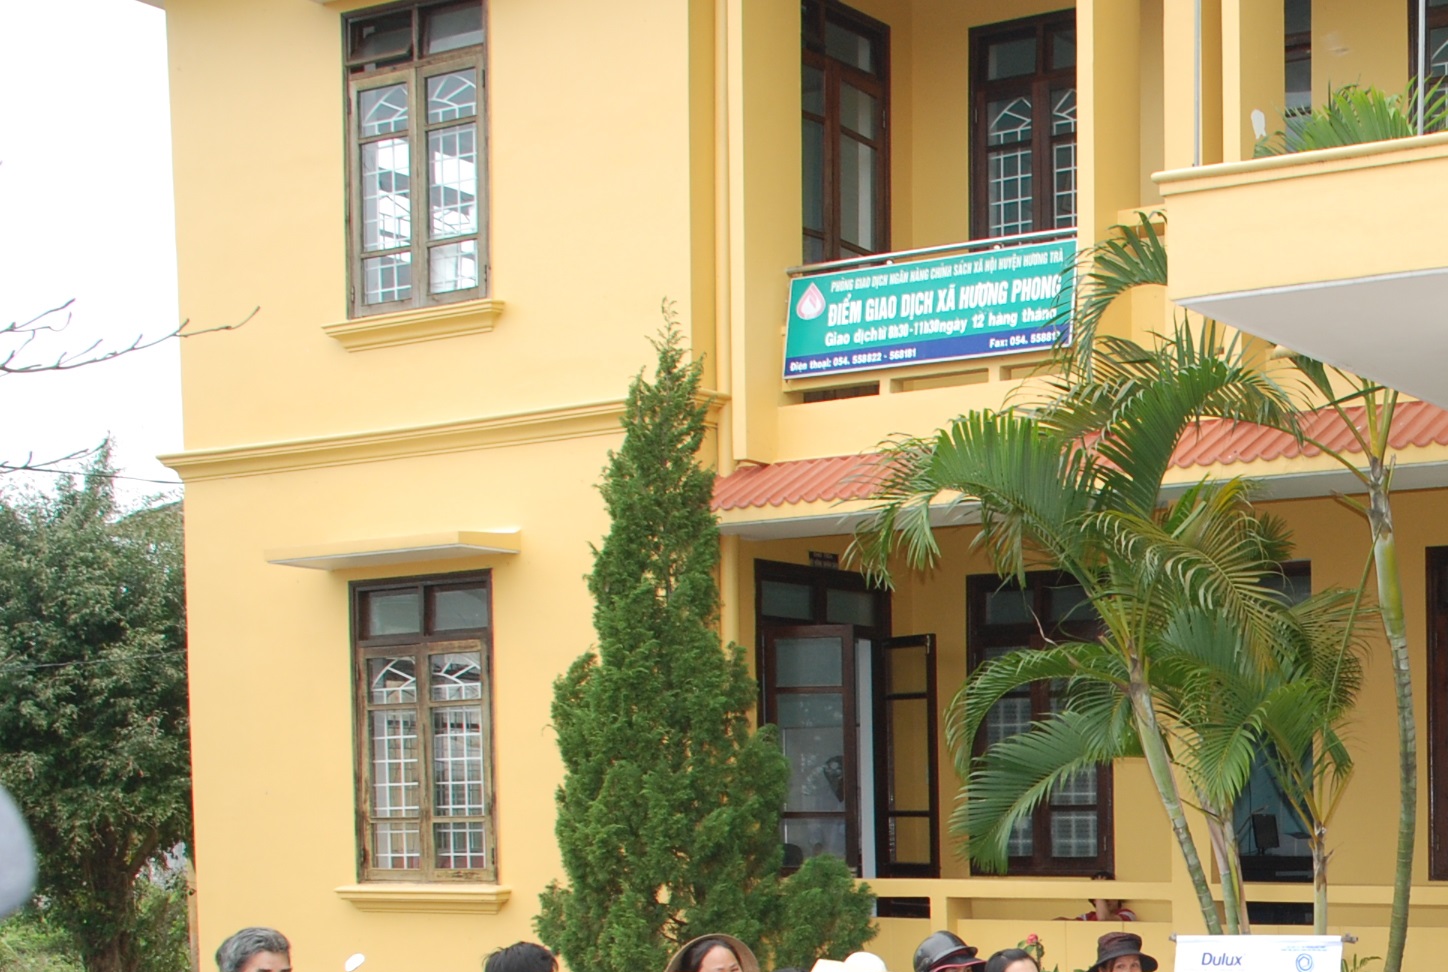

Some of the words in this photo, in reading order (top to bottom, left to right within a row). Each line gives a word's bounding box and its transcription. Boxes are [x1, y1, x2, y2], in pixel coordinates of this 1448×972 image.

[855, 276, 871, 289] GIAO
[872, 274, 888, 290] DỊCH
[828, 292, 863, 327] ĐIỂM
[865, 295, 898, 322] GIAO
[900, 290, 934, 320] DỊCH
[936, 283, 956, 313] XÃ
[958, 280, 1009, 309] HƯƠNG
[1011, 274, 1062, 303] PHONG
[825, 331, 850, 347] Giao
[854, 326, 877, 345] dịch
[972, 312, 986, 329] 12
[988, 310, 1018, 327] hàng
[989, 338, 1008, 349] Fax:
[790, 360, 807, 373] Điện
[1201, 952, 1242, 966] Dulux
